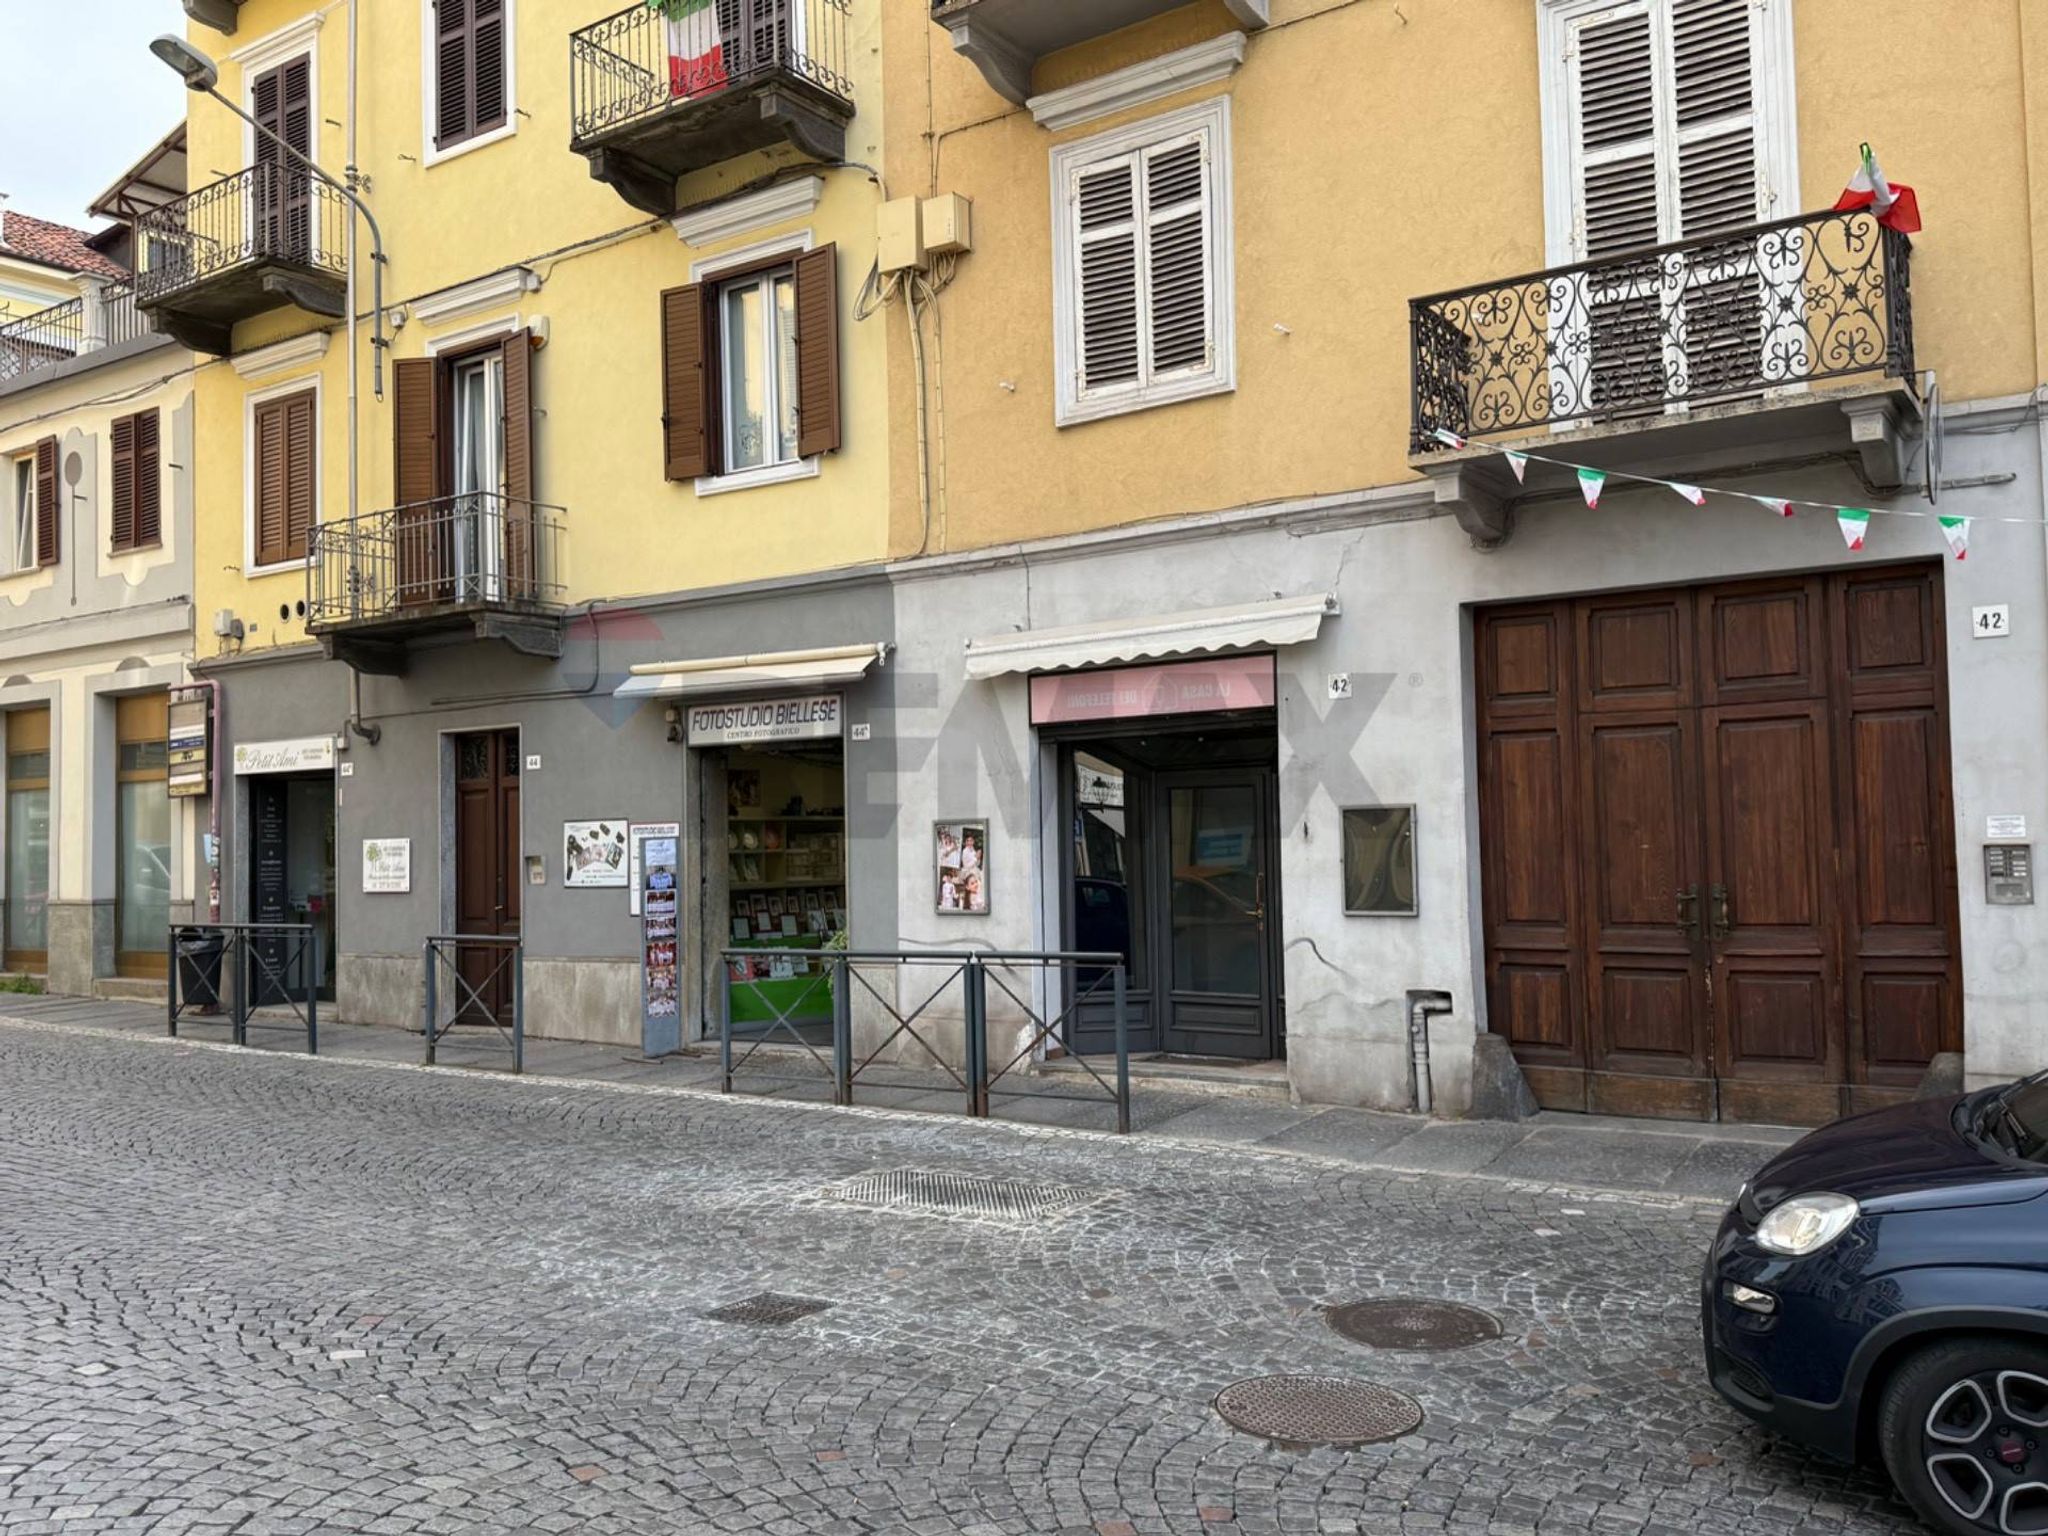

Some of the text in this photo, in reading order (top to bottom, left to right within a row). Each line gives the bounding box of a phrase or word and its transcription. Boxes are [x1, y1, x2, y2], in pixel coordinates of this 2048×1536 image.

[1980, 612, 2002, 630] 42
[1332, 678, 1348, 693] 42
[692, 699, 838, 732] FOTOSTUDIO BIELLESE
[727, 727, 801, 740] CENTRO FOTOGRAFICO
[528, 757, 539, 767] 44
